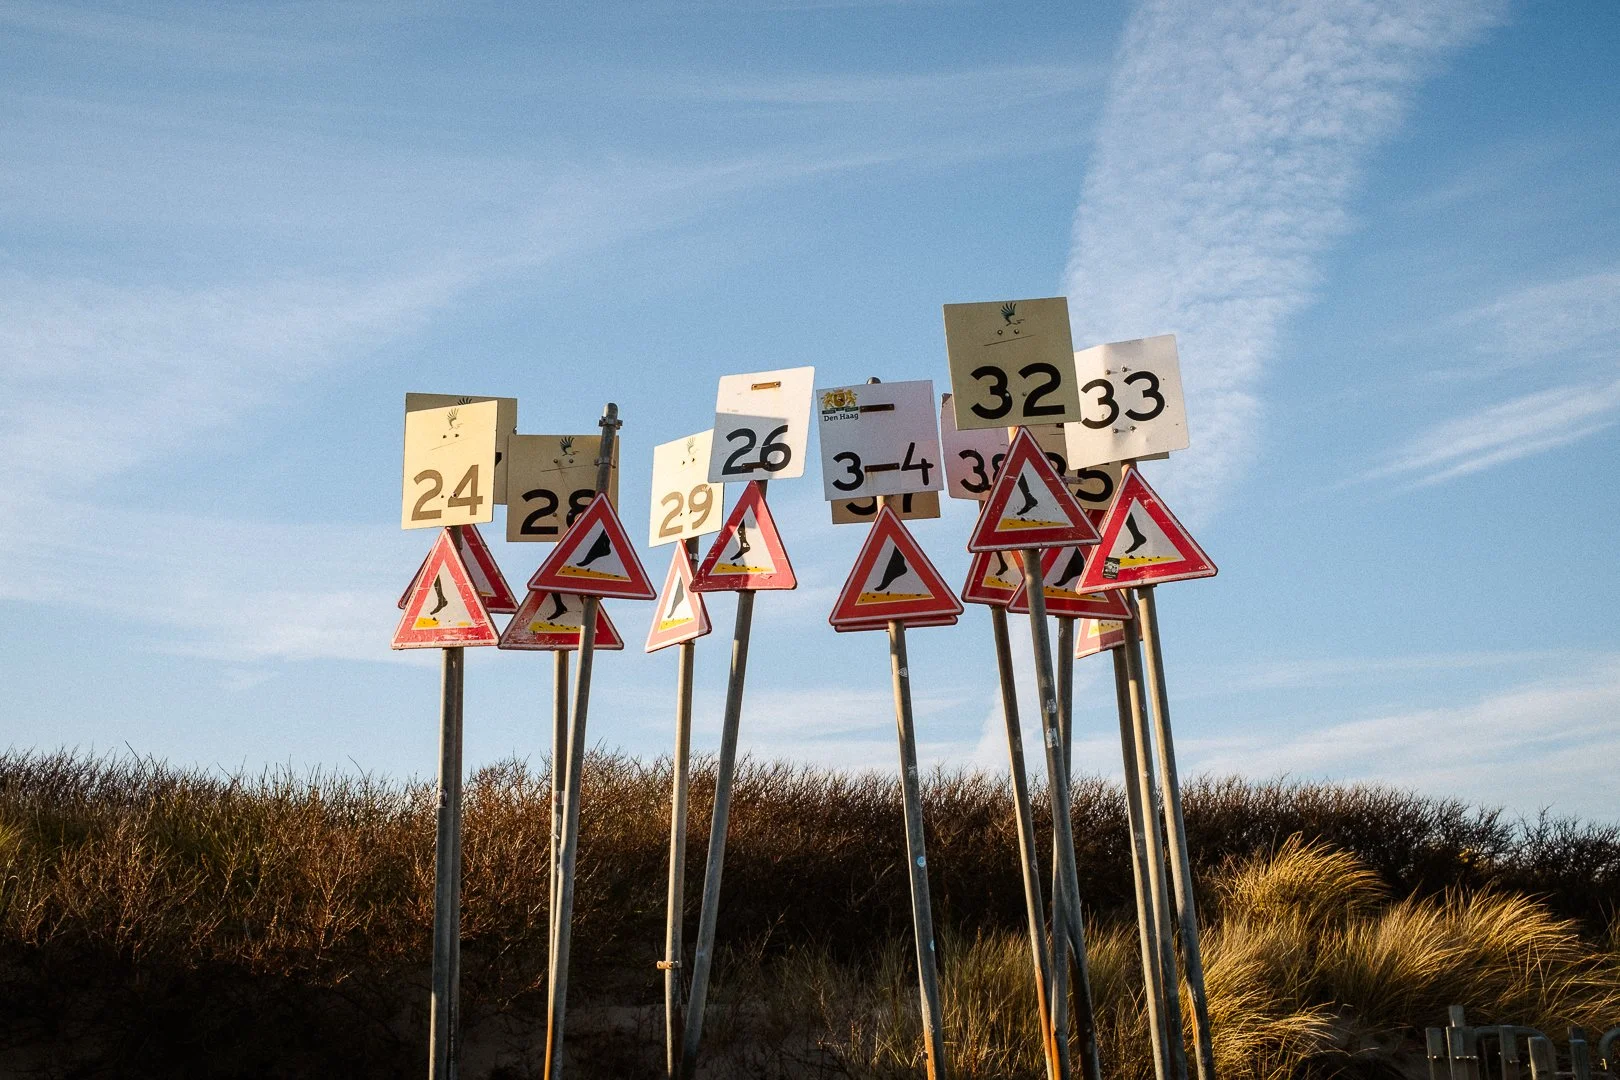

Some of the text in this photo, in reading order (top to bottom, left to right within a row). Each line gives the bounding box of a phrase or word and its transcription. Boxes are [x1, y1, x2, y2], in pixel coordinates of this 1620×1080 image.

[840, 413, 859, 421] Haag
[970, 362, 1066, 420] 32
[1080, 371, 1166, 429] 33
[722, 424, 792, 476] 26
[411, 464, 484, 521] 24
[658, 483, 714, 539] 29
